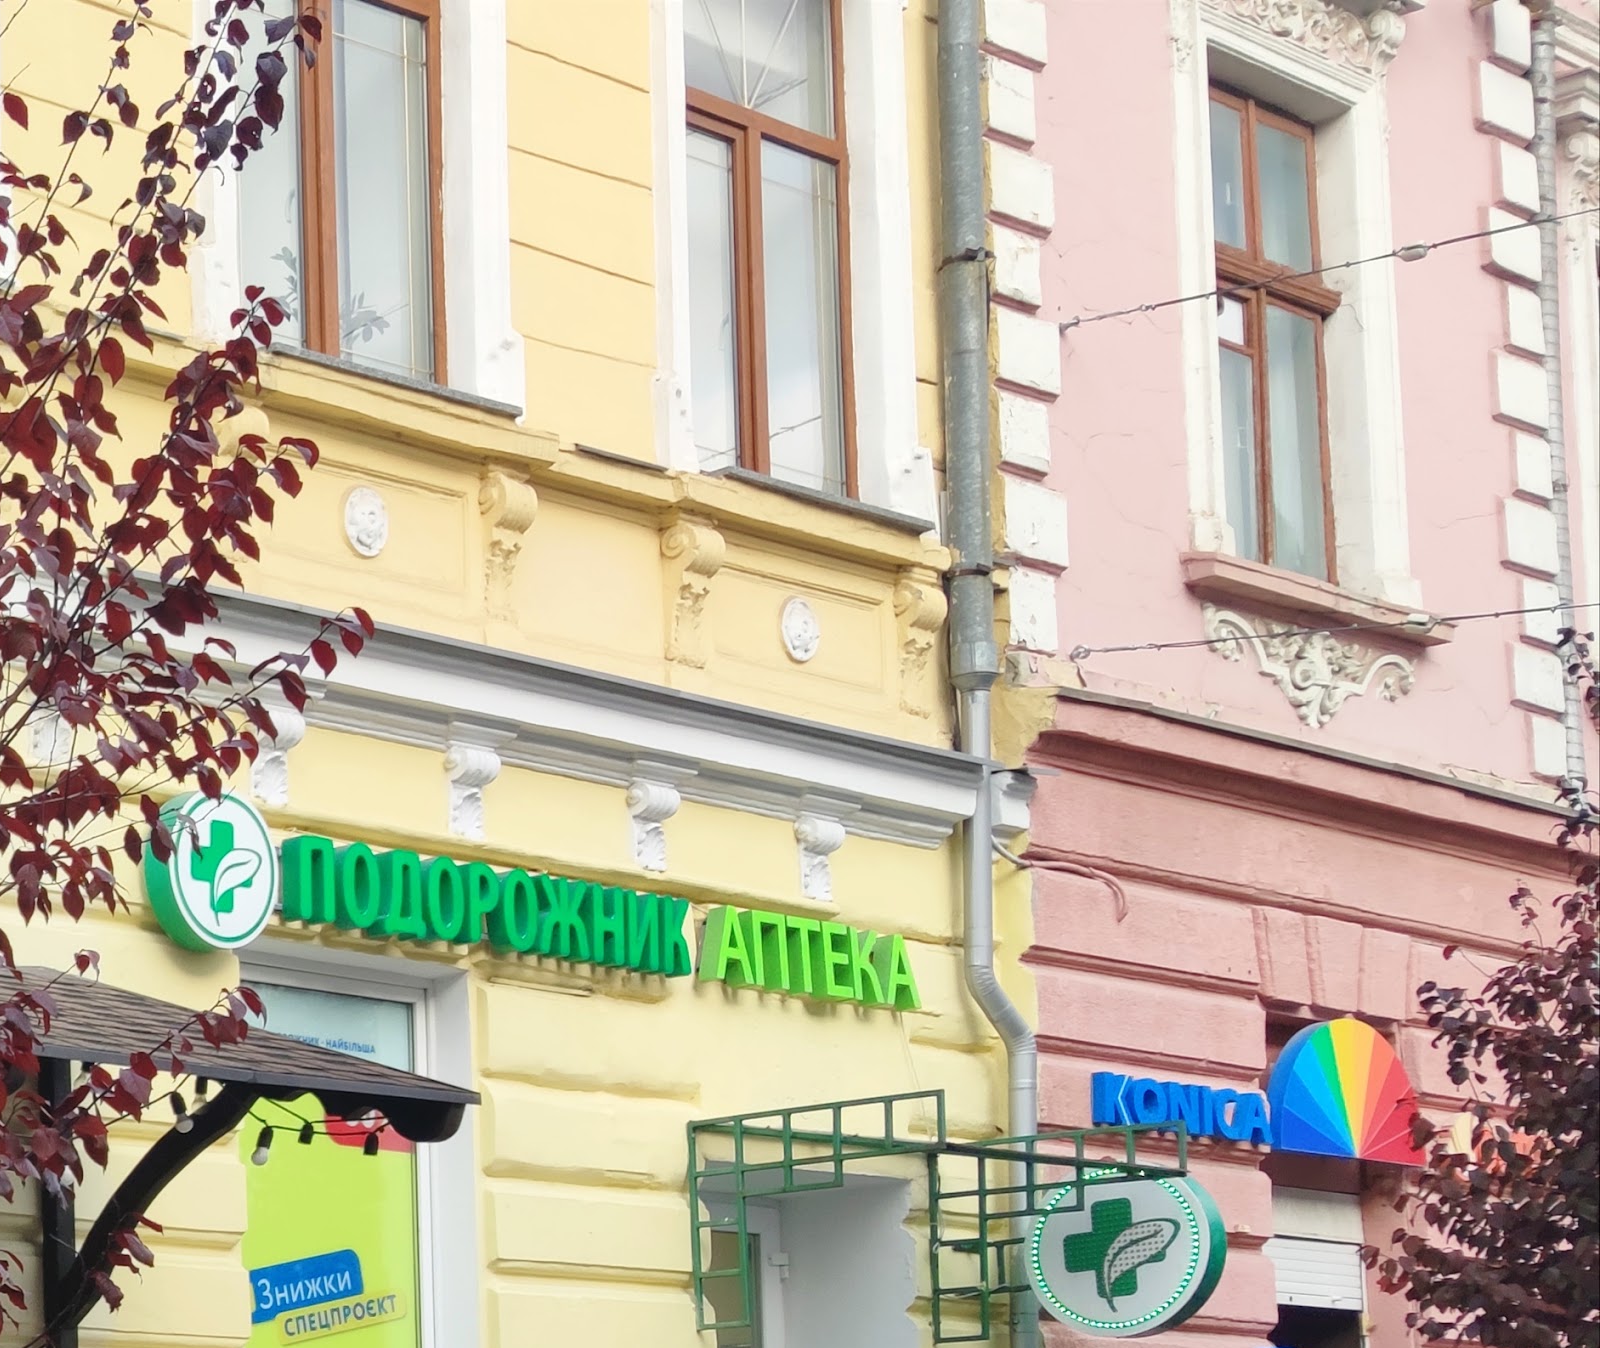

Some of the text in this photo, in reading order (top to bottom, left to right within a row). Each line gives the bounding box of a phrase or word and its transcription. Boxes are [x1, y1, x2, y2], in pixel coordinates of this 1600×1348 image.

[284, 835, 922, 1010] ПОДОРОЖНИК АПТЕКА
[326, 1038, 376, 1054] НАЙБІЛЬША
[1092, 1072, 1274, 1144] KONICA
[284, 1295, 397, 1336] СПЕЦПРОЄКТ
